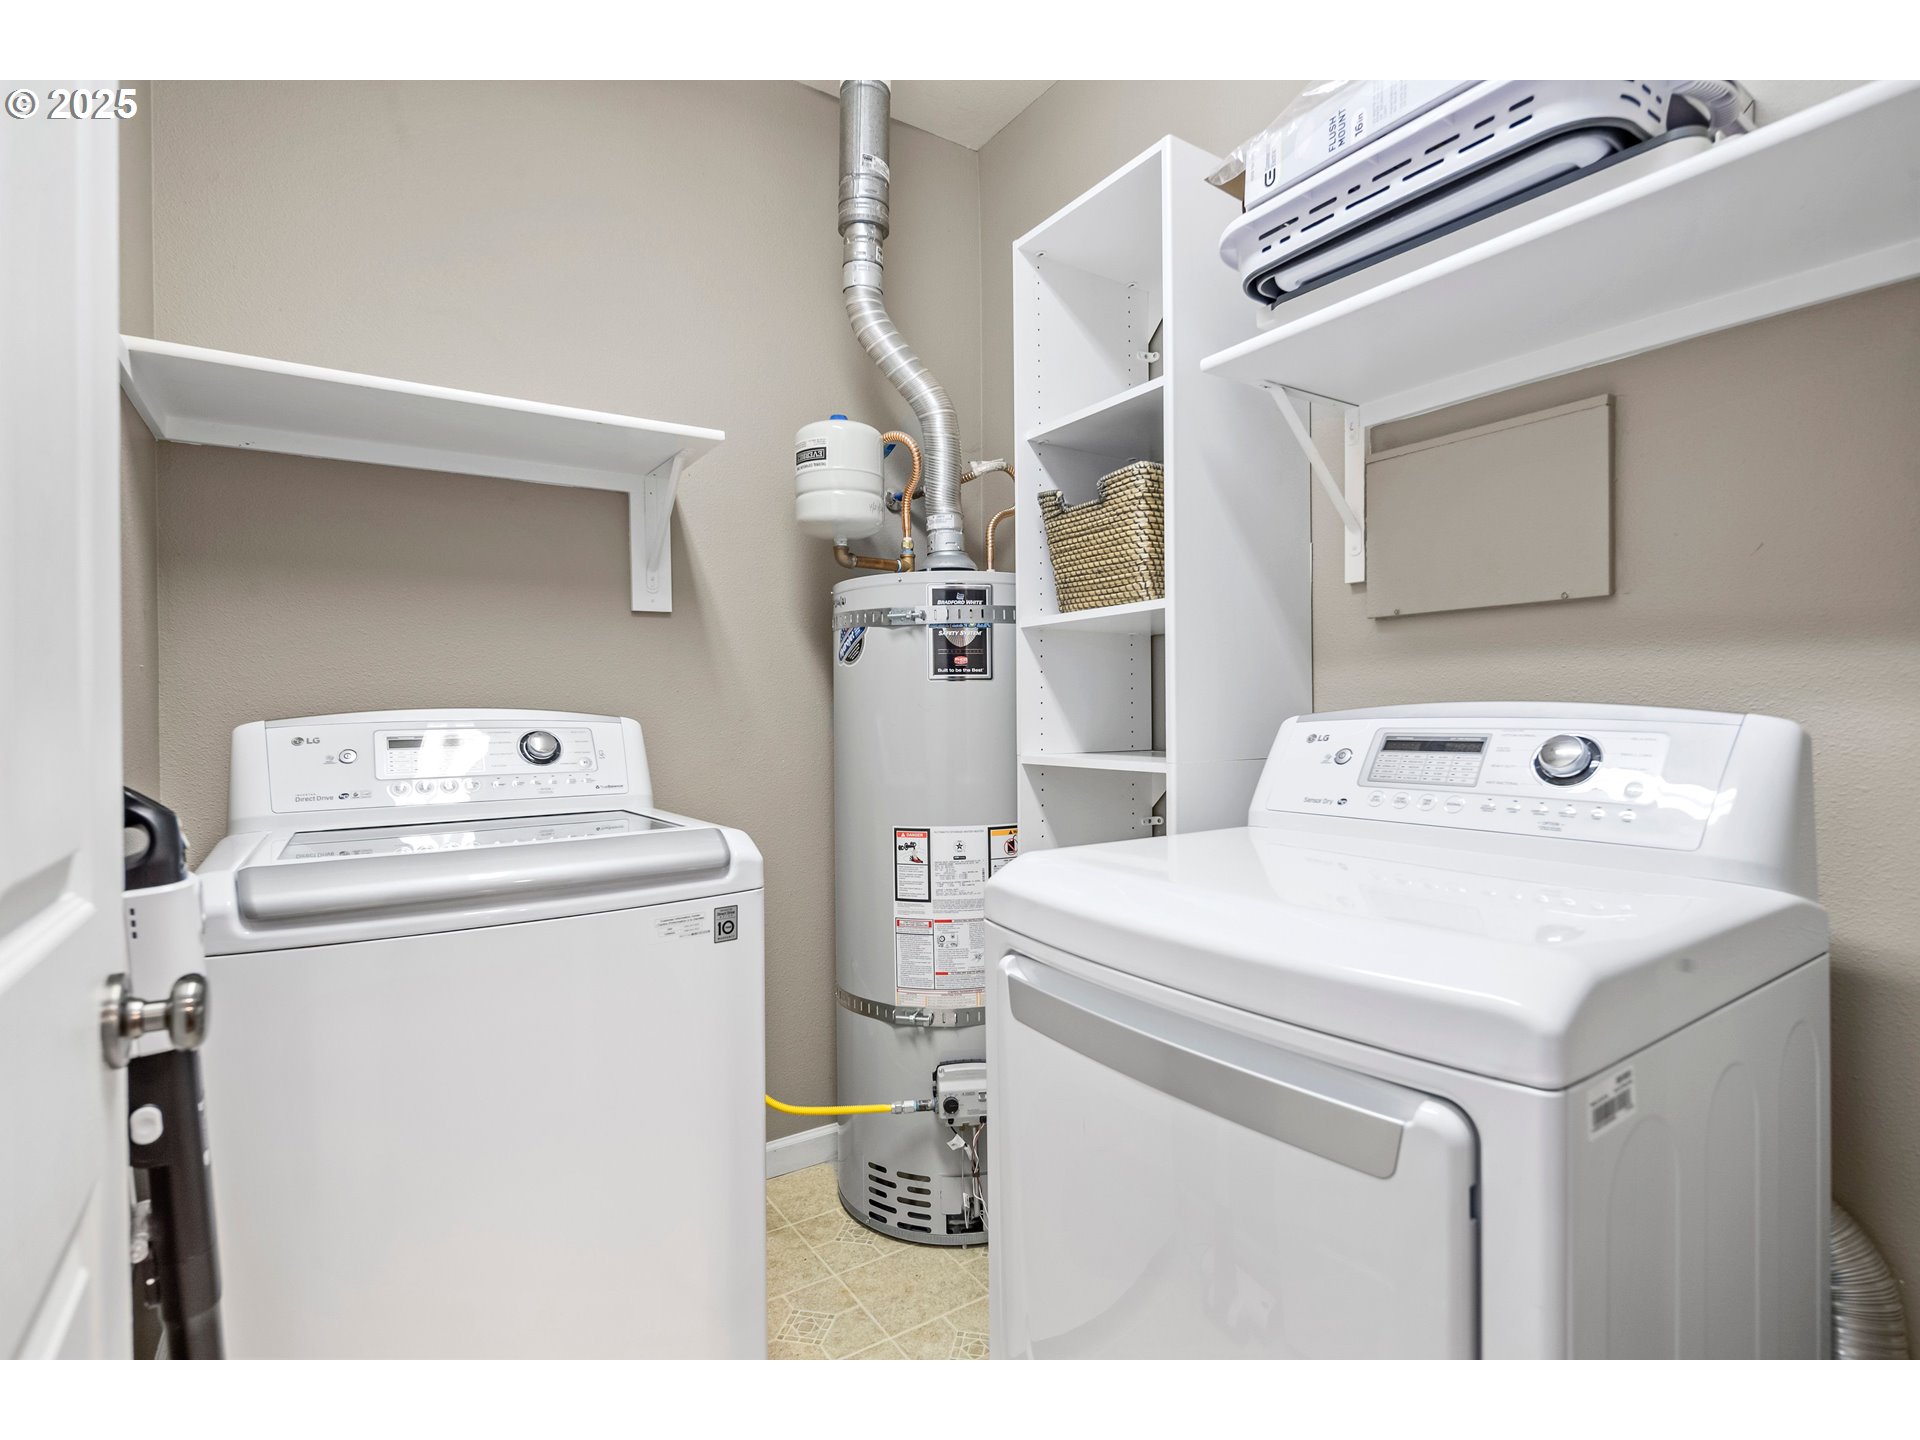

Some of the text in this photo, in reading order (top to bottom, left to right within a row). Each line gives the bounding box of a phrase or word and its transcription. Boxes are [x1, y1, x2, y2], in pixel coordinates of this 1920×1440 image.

[1328, 116, 1337, 152] FLUSH
[1338, 108, 1347, 148] MOUNT
[306, 737, 321, 745] LG
[1317, 734, 1330, 742] LG
[295, 795, 316, 803] Direct
[316, 794, 334, 802] Drive
[717, 920, 735, 936] 10
